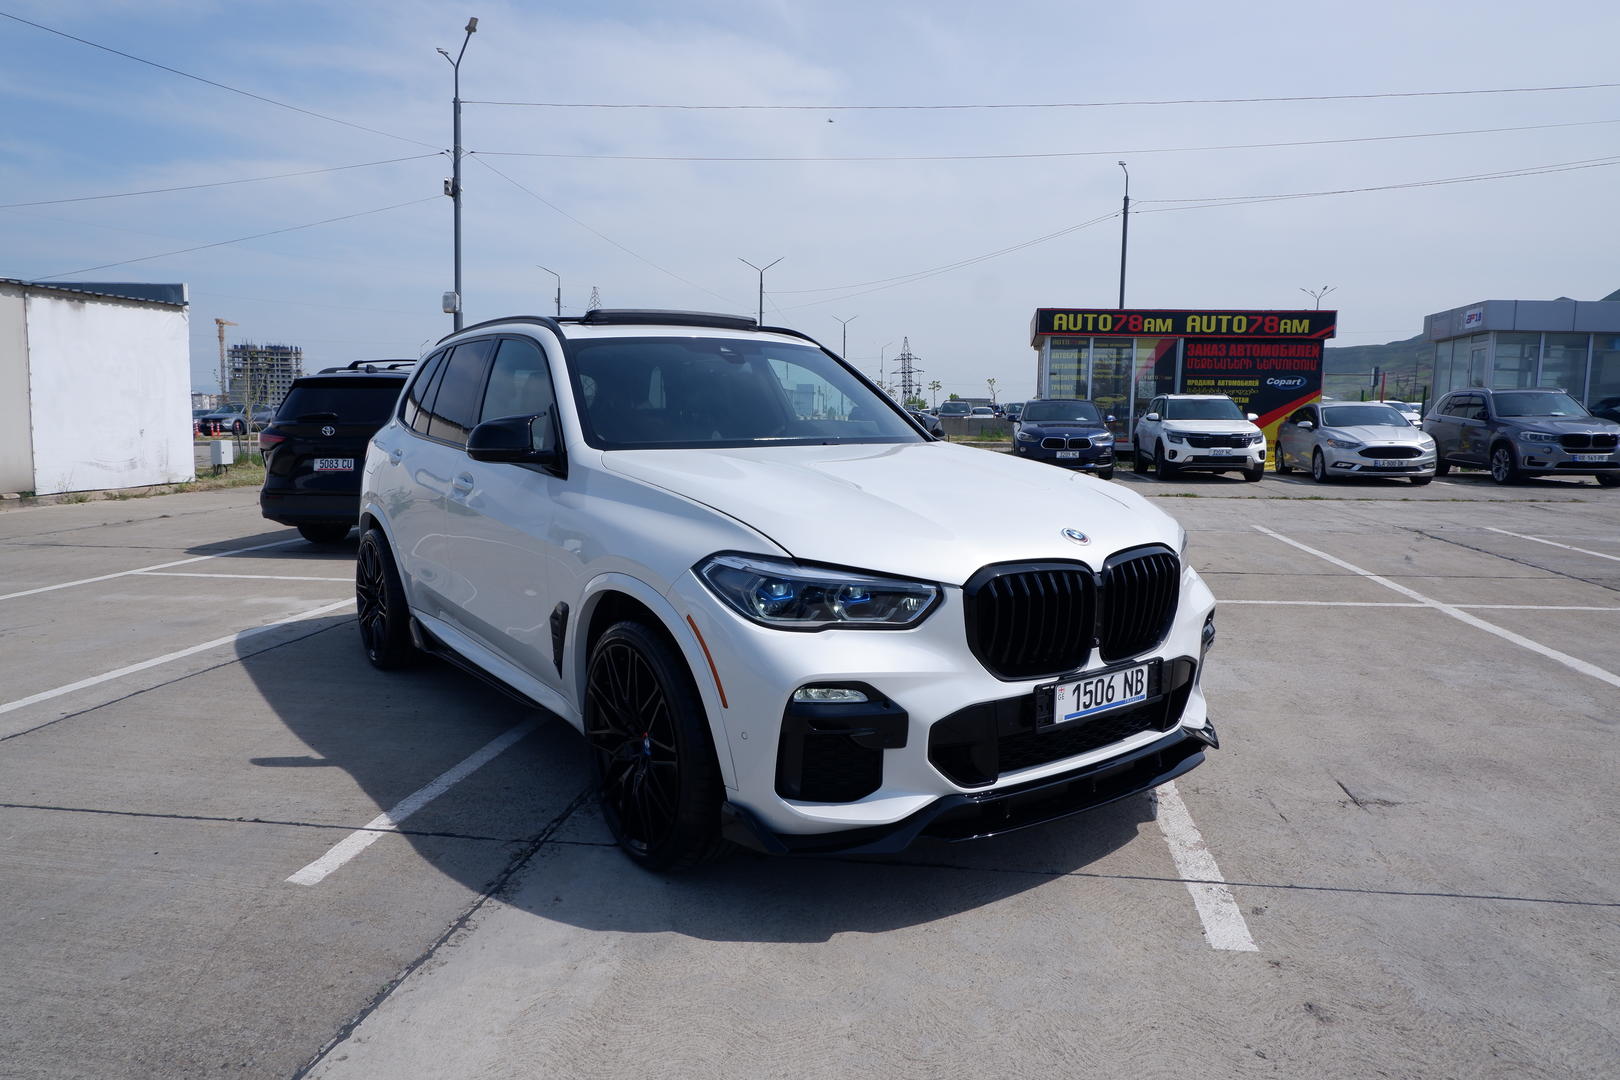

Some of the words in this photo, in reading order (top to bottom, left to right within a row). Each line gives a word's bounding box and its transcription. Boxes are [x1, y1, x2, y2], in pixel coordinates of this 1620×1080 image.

[1187, 343, 1226, 356] ЗАКАЗ
[1229, 343, 1320, 358] АВТОМОБИЛЕЙ
[1266, 377, 1302, 386] Copart
[319, 459, 339, 468] 5083
[342, 459, 352, 468] CU
[1072, 675, 1115, 711] 1506
[1123, 668, 1145, 698] NB
